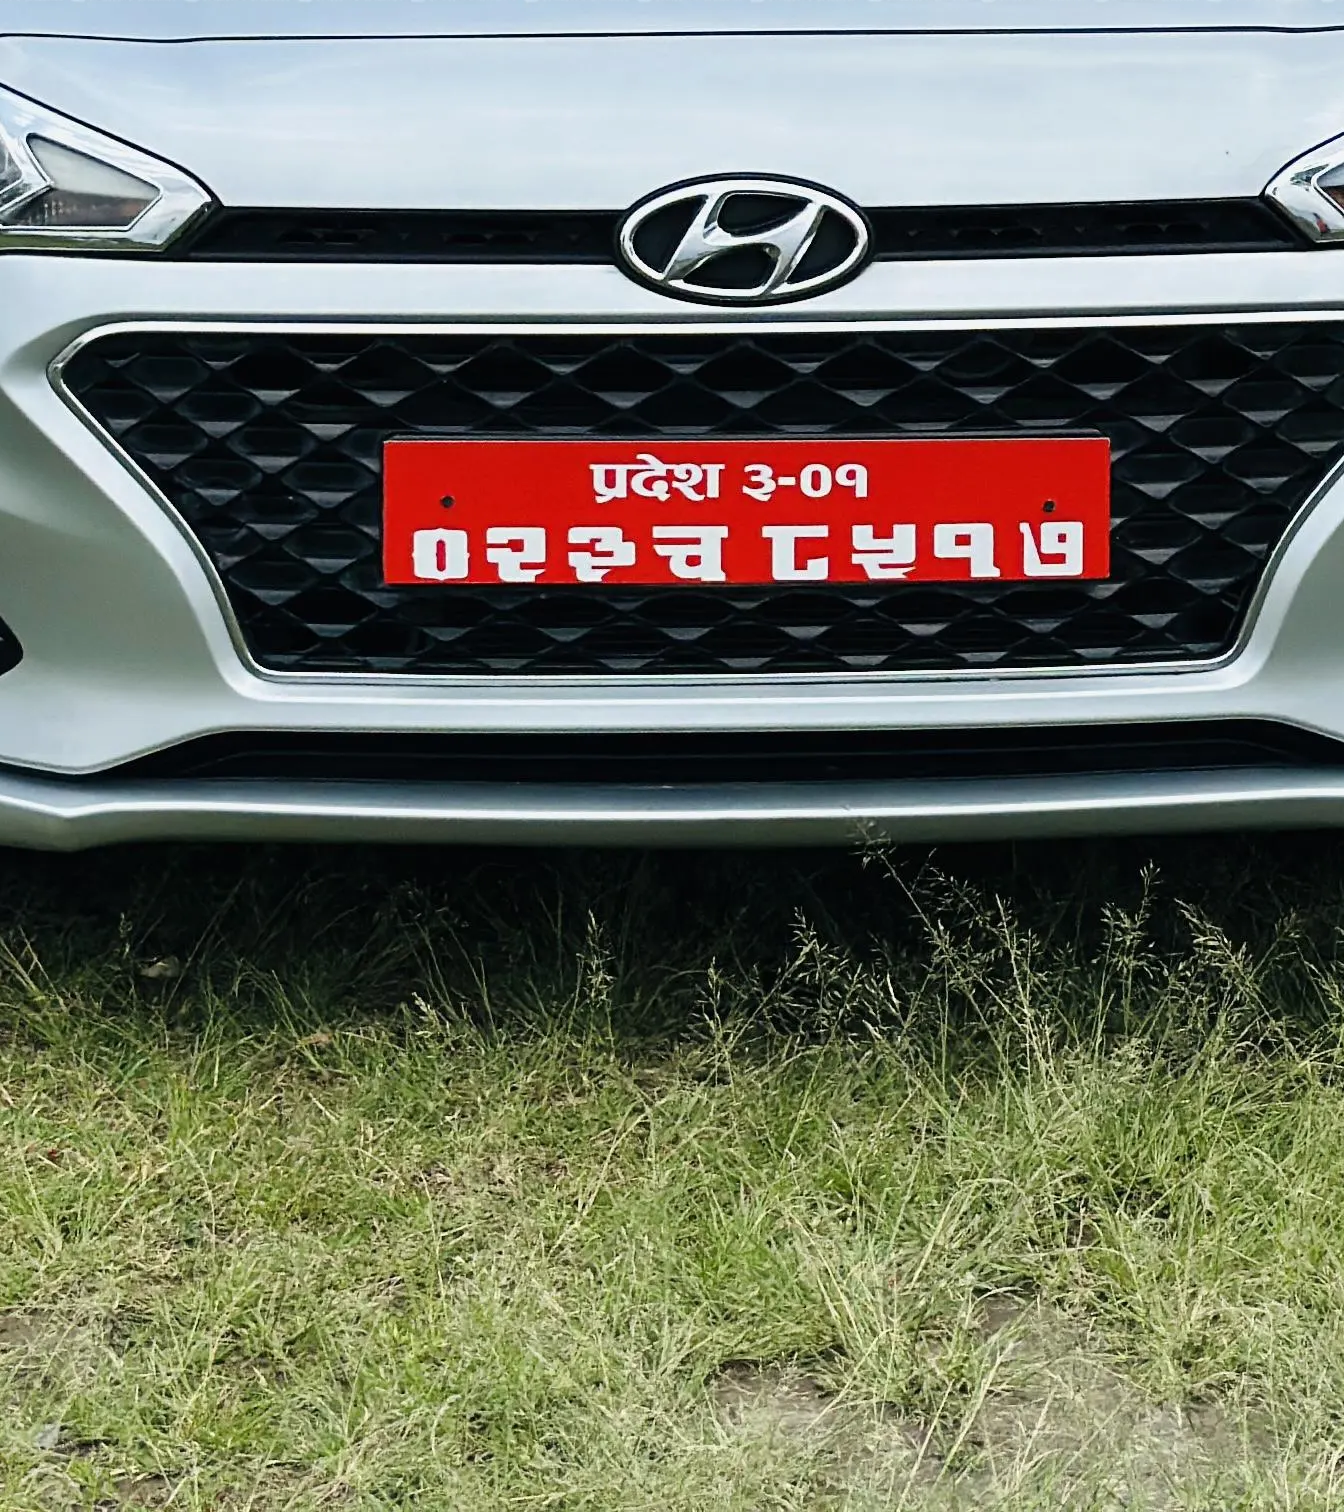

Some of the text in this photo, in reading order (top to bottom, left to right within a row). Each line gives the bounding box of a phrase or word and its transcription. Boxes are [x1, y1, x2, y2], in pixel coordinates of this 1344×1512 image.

[589, 453, 868, 503] प्रदेश ३-०१
[761, 521, 1084, 580] ८५१७
